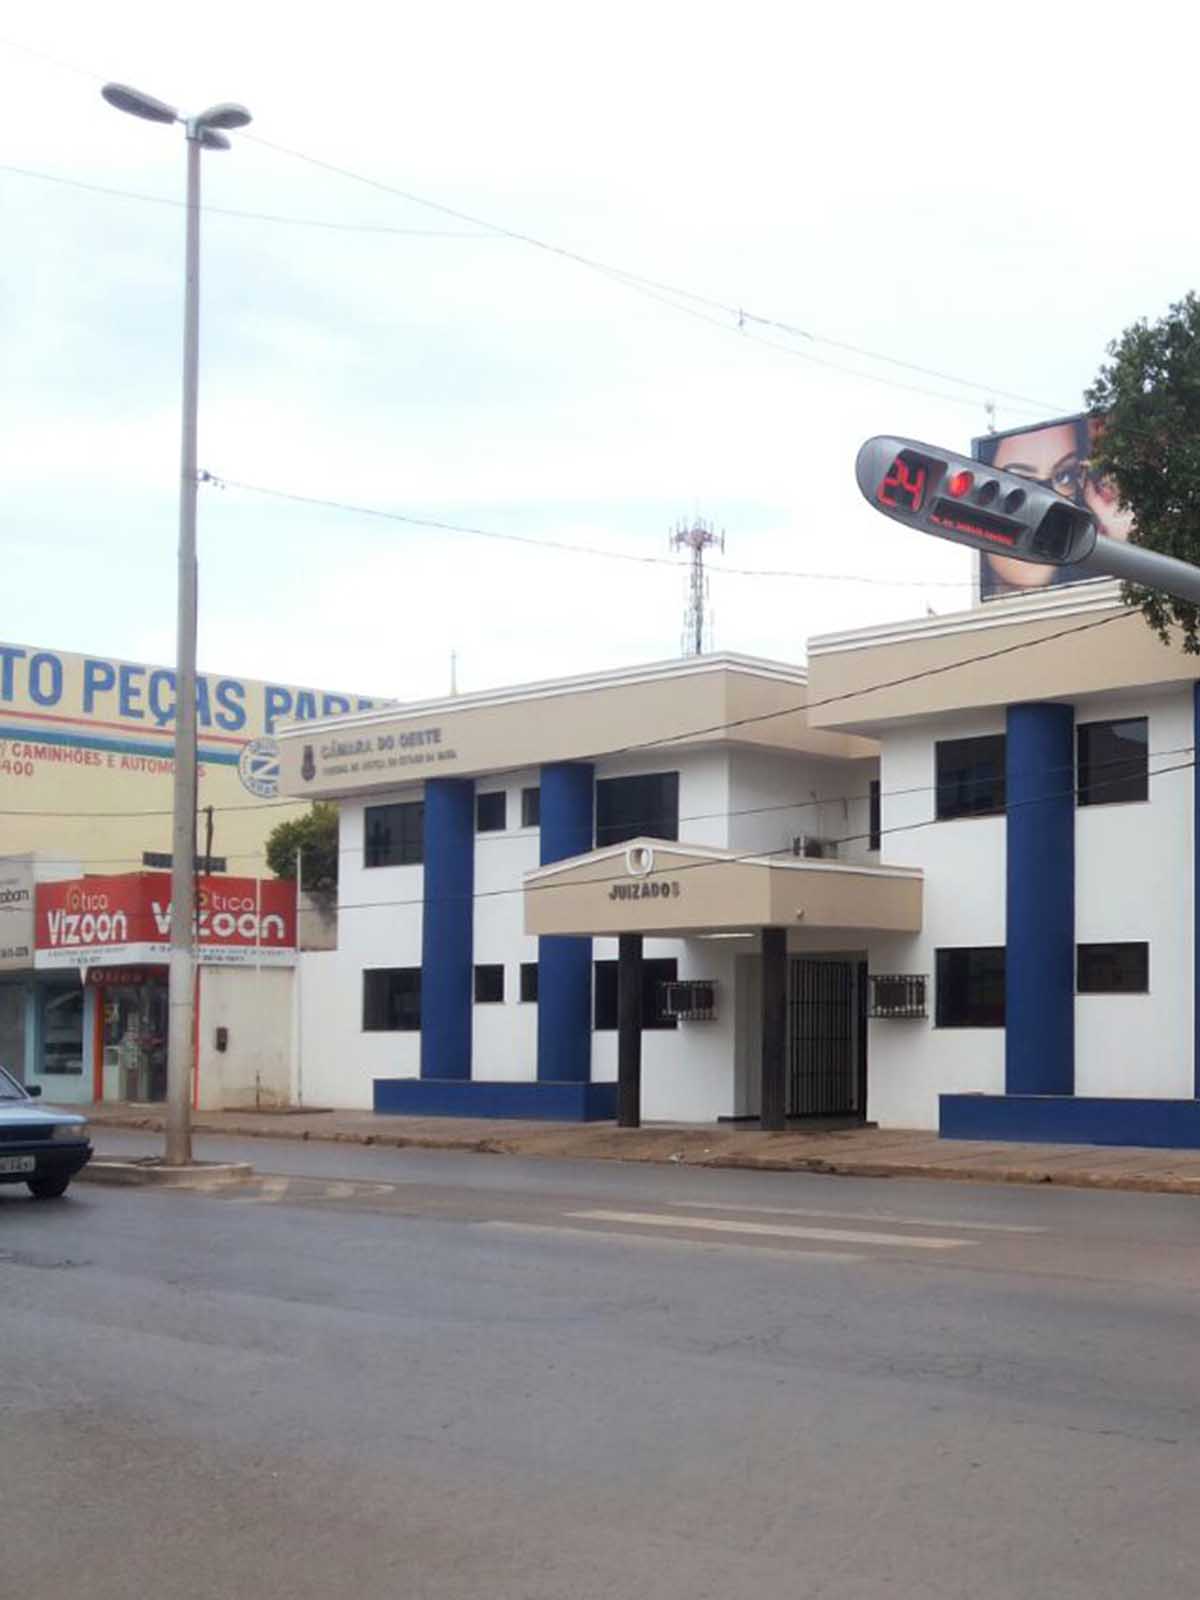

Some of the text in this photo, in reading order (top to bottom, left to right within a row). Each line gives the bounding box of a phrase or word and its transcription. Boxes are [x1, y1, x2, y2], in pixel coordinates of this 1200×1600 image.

[876, 456, 926, 512] 24
[0, 646, 63, 706] TO
[264, 685, 373, 734] PA
[609, 881, 680, 900] JUIZADOS
[152, 901, 285, 939] Vzoon
